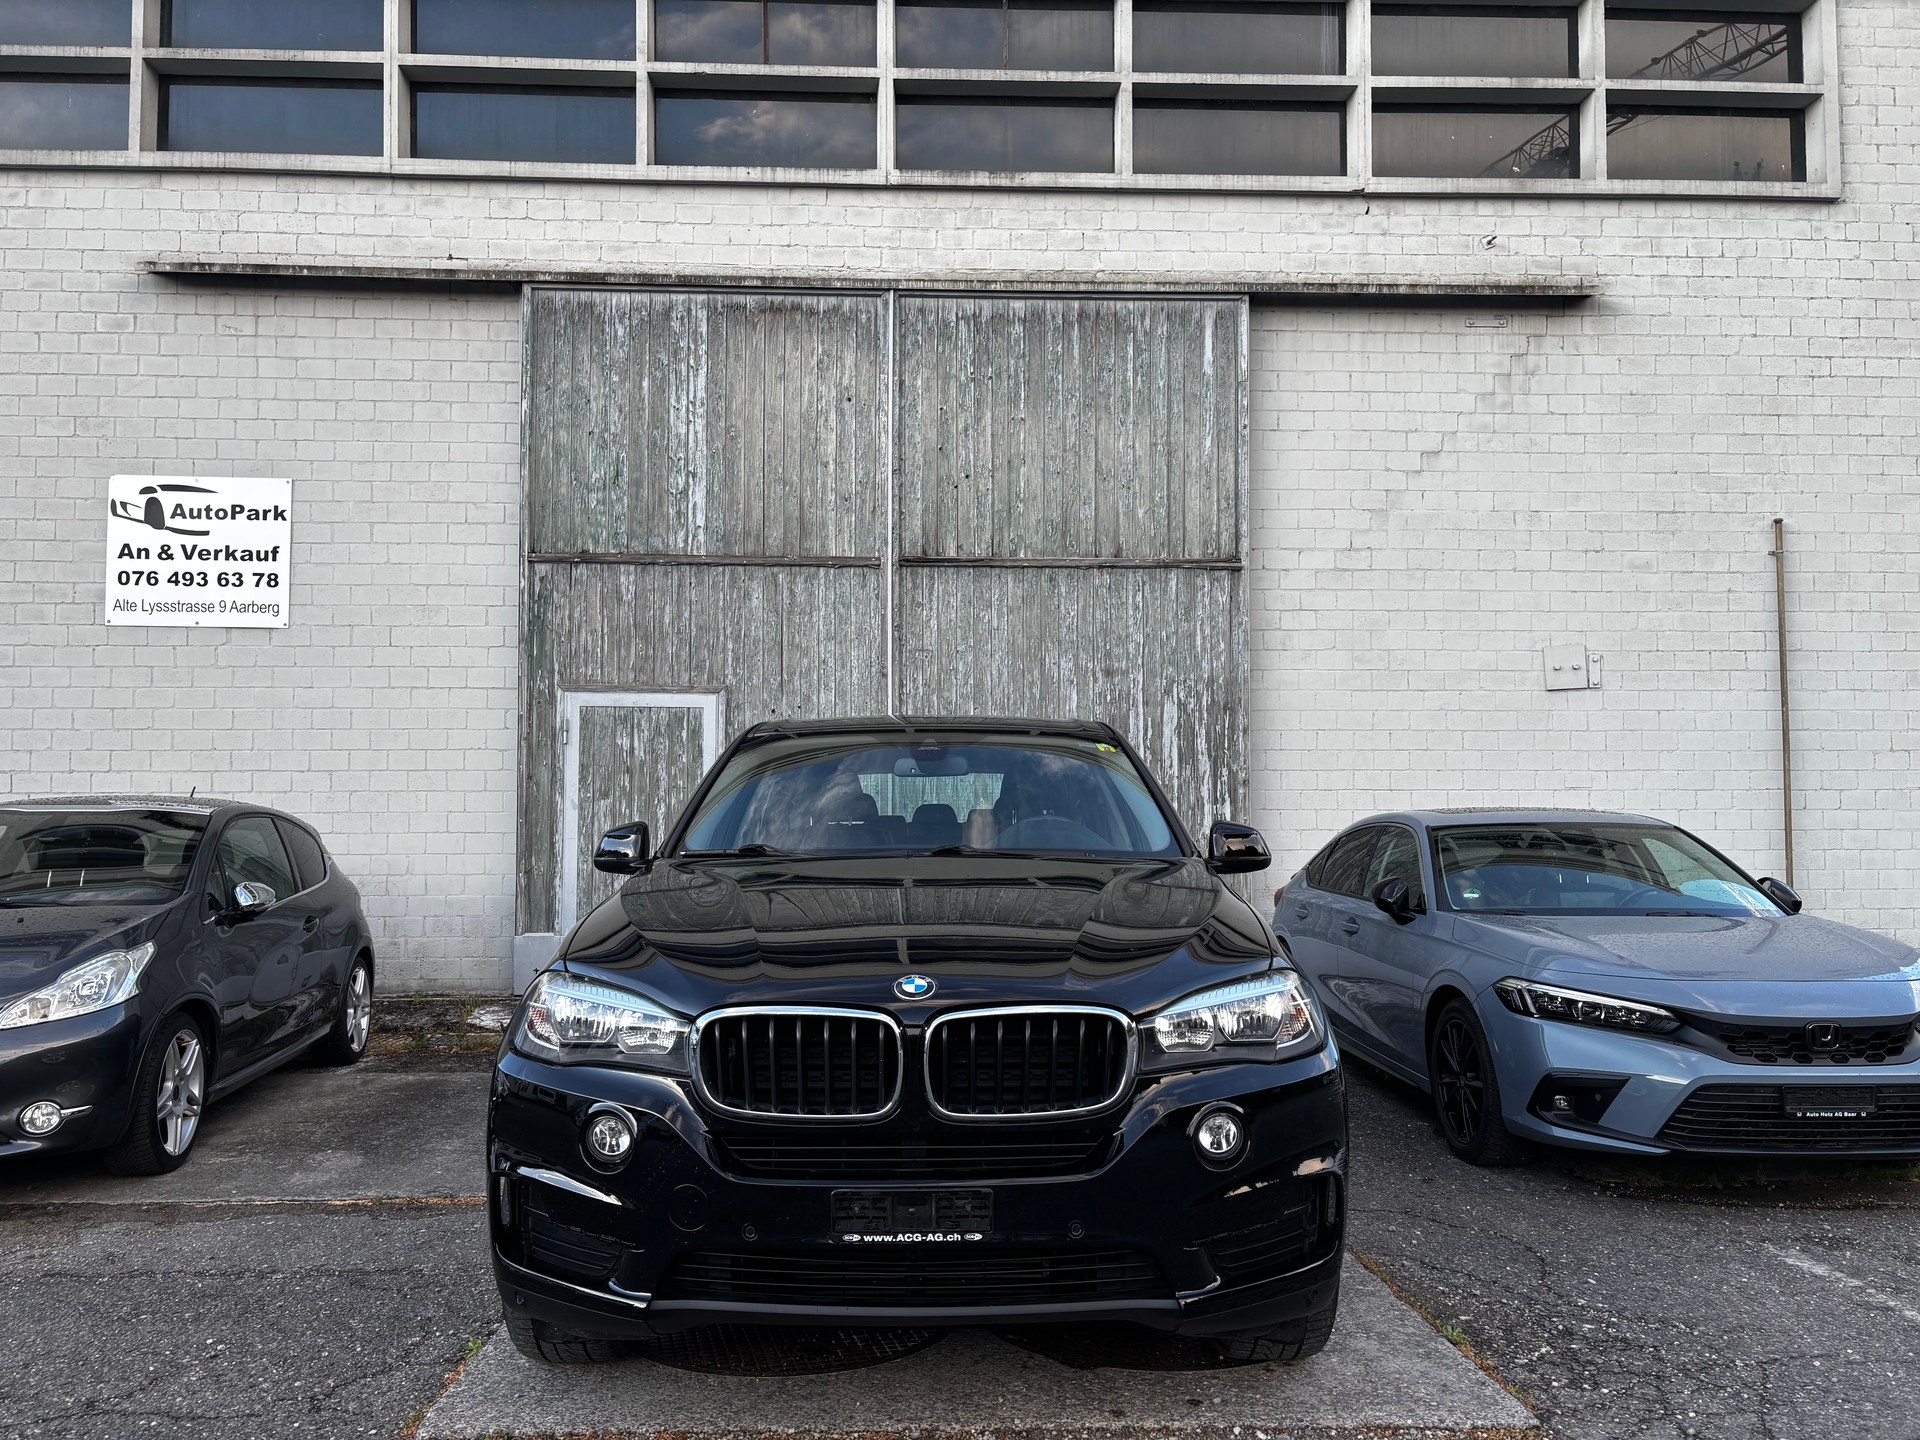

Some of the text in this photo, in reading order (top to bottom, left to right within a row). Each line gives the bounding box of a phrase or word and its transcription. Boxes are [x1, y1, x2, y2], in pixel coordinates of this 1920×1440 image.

[169, 503, 287, 522] AutoPark
[117, 543, 280, 562] An & Verkauf
[117, 570, 280, 588] 076 493 63 78
[113, 598, 280, 617] Alte Lyssstrasse 9 Aarberg
[863, 1233, 961, 1242] www.ACG-AG.ch
